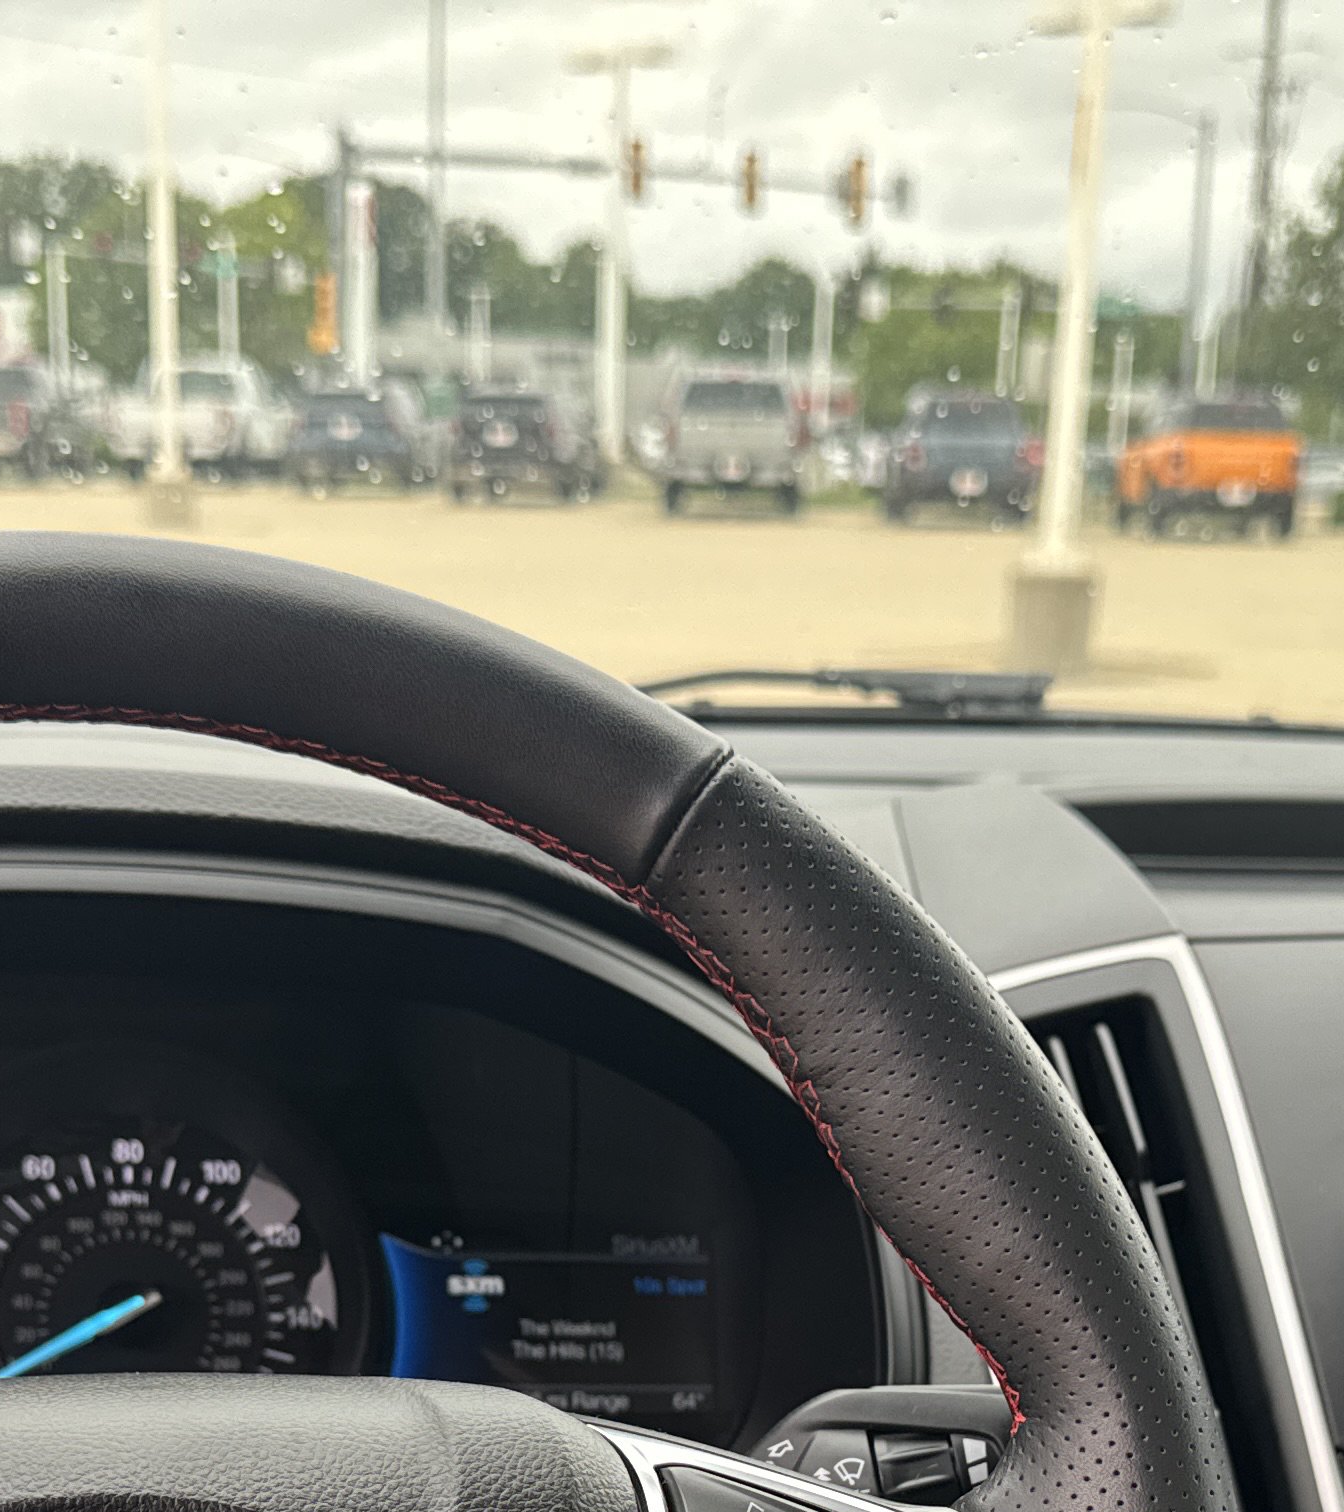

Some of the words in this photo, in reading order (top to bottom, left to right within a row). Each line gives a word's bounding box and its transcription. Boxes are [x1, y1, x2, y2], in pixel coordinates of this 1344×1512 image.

[111, 1138, 145, 1165] 80
[21, 1155, 56, 1181] 60
[201, 1159, 242, 1185] 100
[571, 1391, 629, 1414] Range
